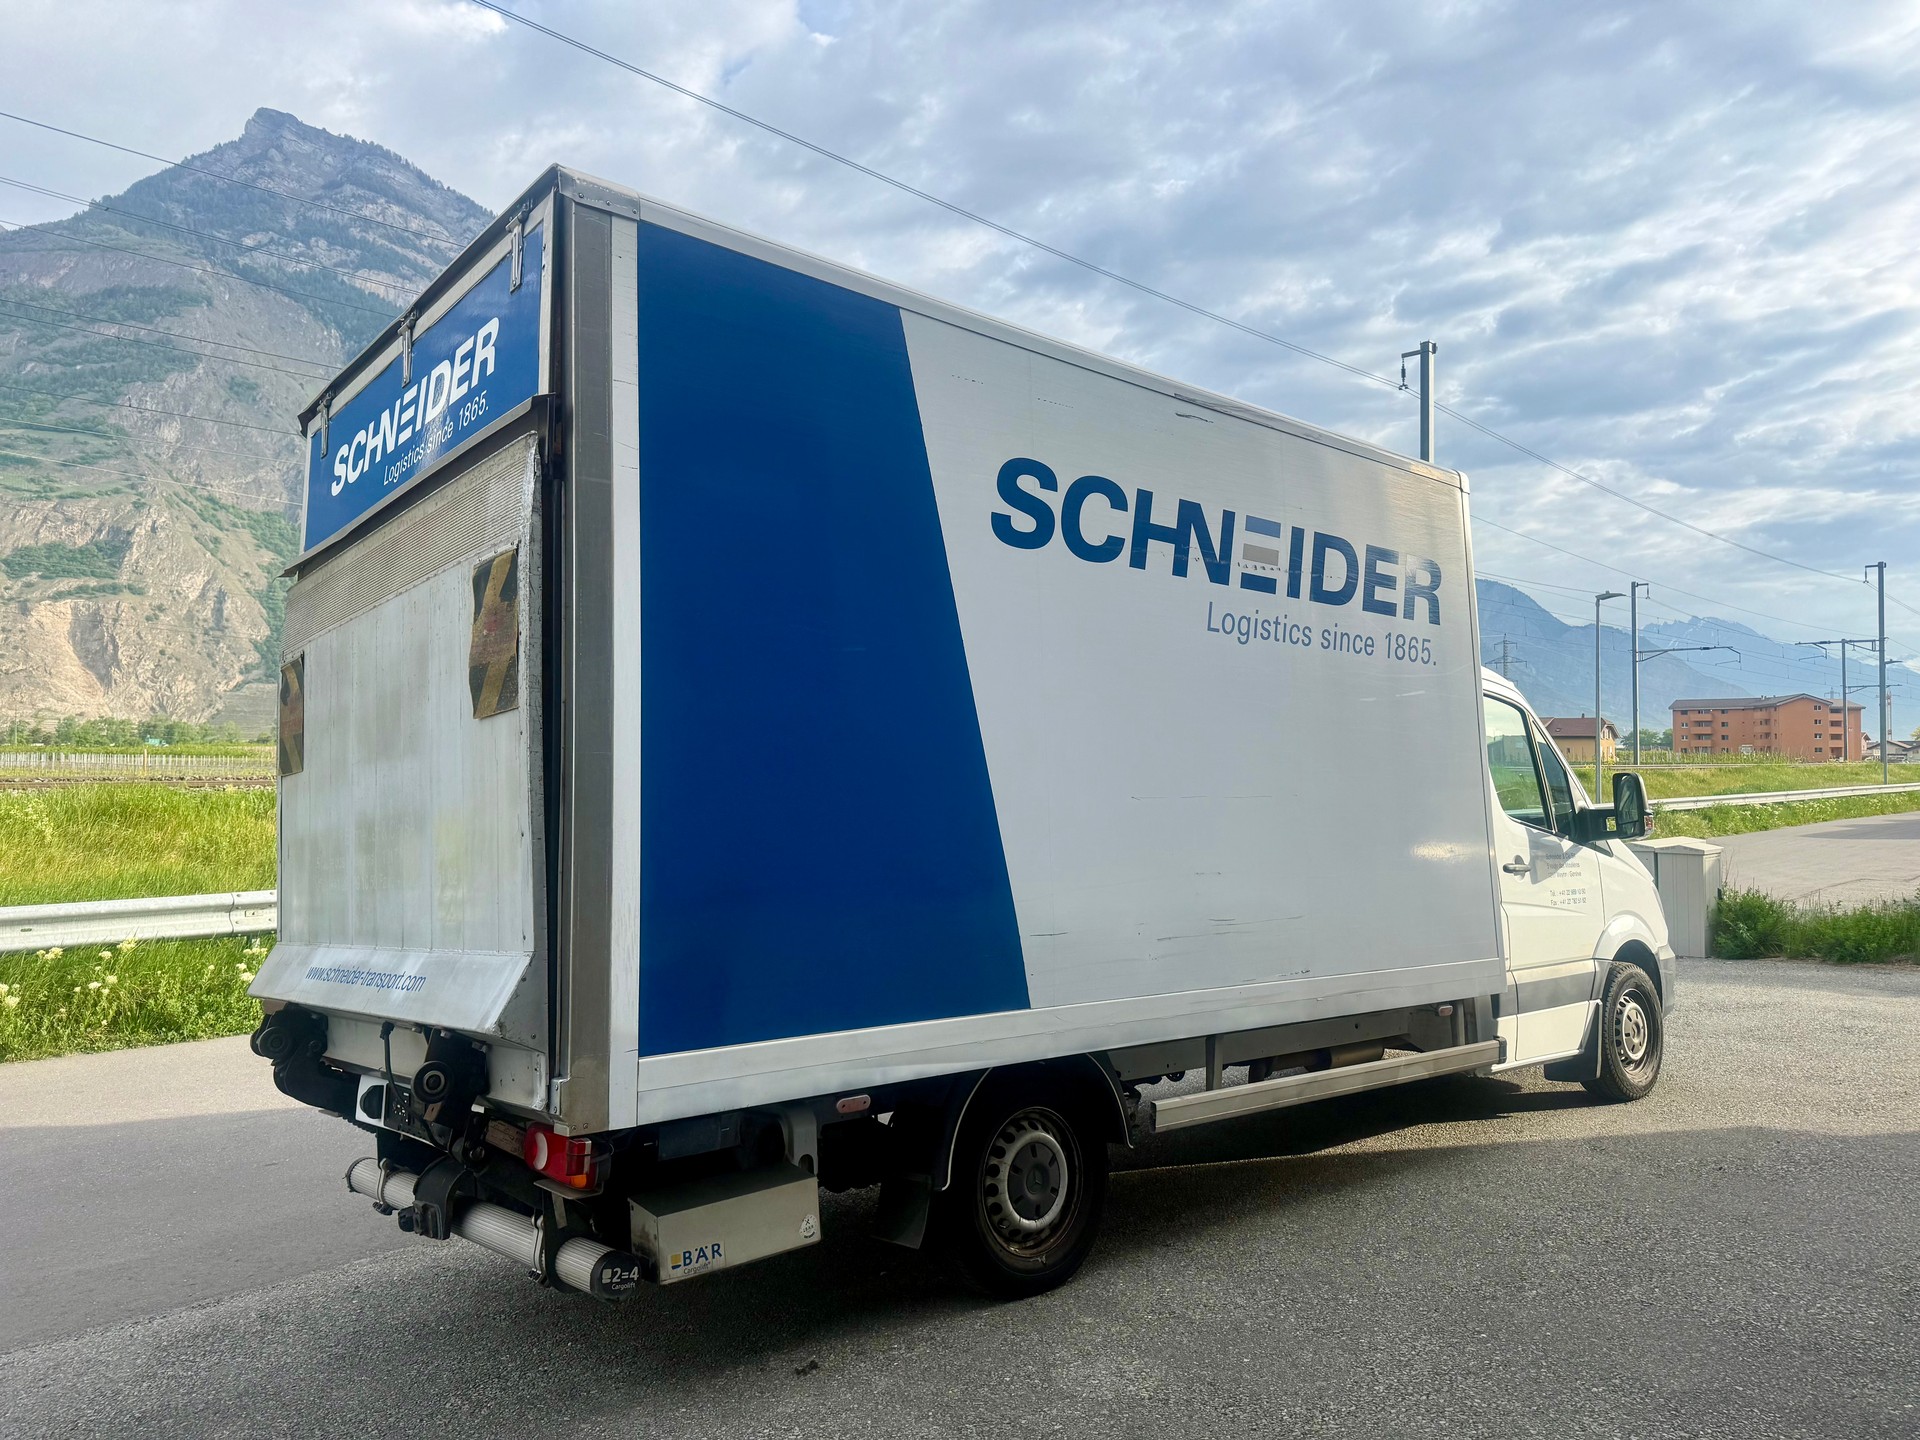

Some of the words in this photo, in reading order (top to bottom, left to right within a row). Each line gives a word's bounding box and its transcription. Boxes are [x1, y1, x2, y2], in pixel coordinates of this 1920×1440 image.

[331, 317, 500, 497] SCHNEIDER
[383, 445, 425, 486] Logistics
[426, 420, 454, 454] since
[458, 390, 489, 431] 1865.
[990, 457, 1443, 627] SCHNEIDER
[1207, 601, 1313, 647] Logistics
[1320, 623, 1375, 657] since
[1384, 631, 1438, 667] 1865.
[305, 964, 427, 993] www.schneider-transport.com
[682, 1243, 723, 1267] BÄR
[683, 1263, 710, 1275] Cargolift
[611, 1281, 636, 1291] Cargolift
[612, 1266, 640, 1283] 2=4
